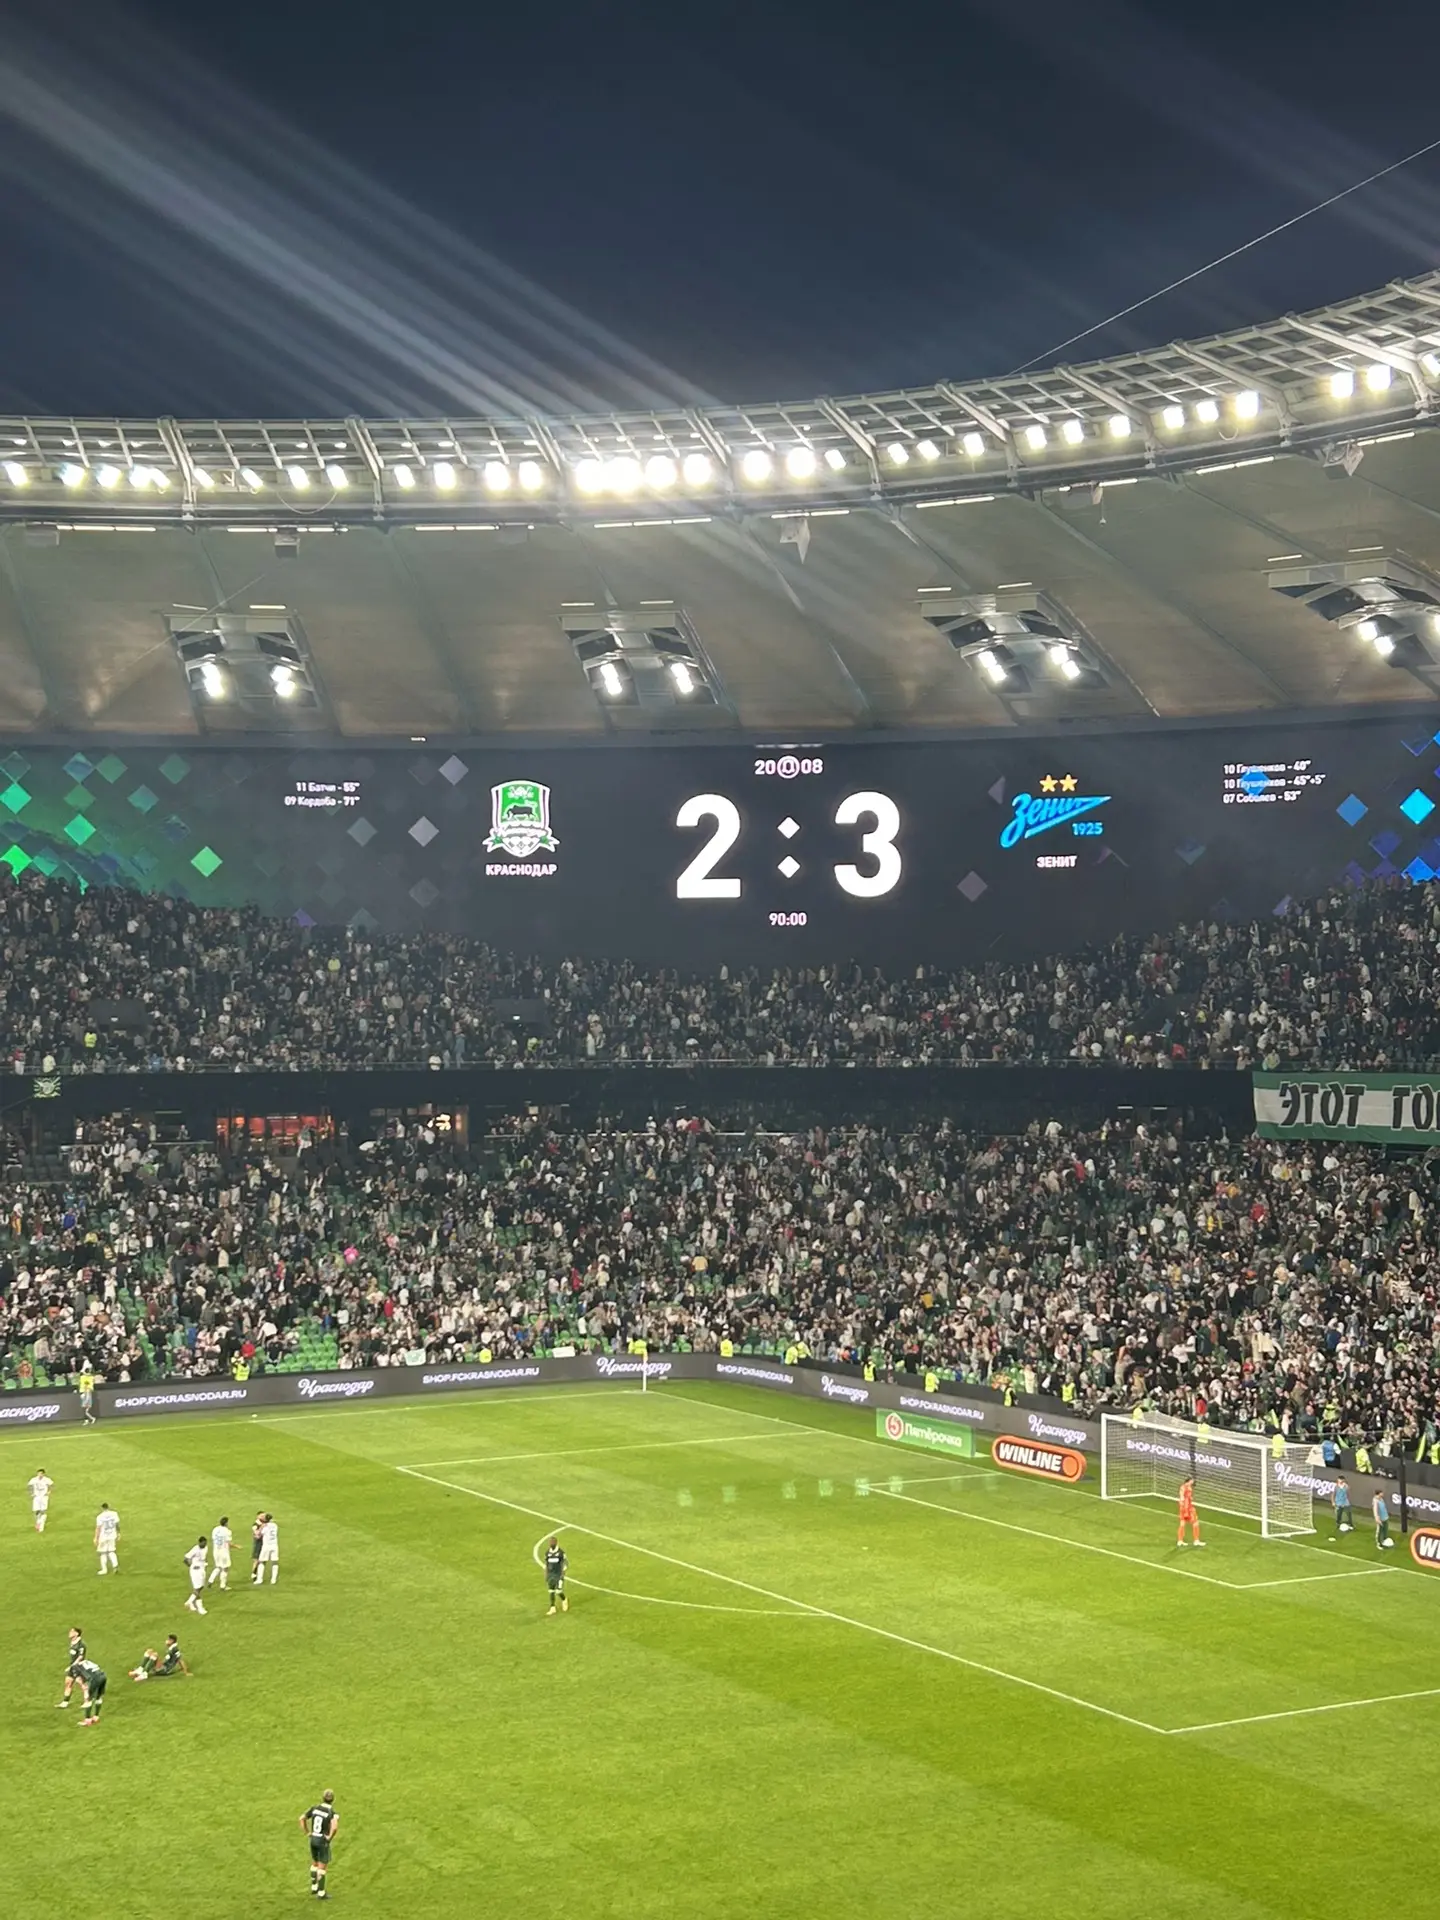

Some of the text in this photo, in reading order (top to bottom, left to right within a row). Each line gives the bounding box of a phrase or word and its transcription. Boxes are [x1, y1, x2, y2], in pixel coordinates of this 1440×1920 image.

[1072, 822, 1104, 836] 1925
[1036, 856, 1078, 868] ЗЕНИТ
[485, 864, 558, 877] КРАСНОДАР
[769, 912, 808, 926] 90:00
[1278, 1081, 1367, 1129] ЭТОТ
[1000, 1442, 1062, 1472] WINLINE
[1274, 1462, 1337, 1496] Краснода
